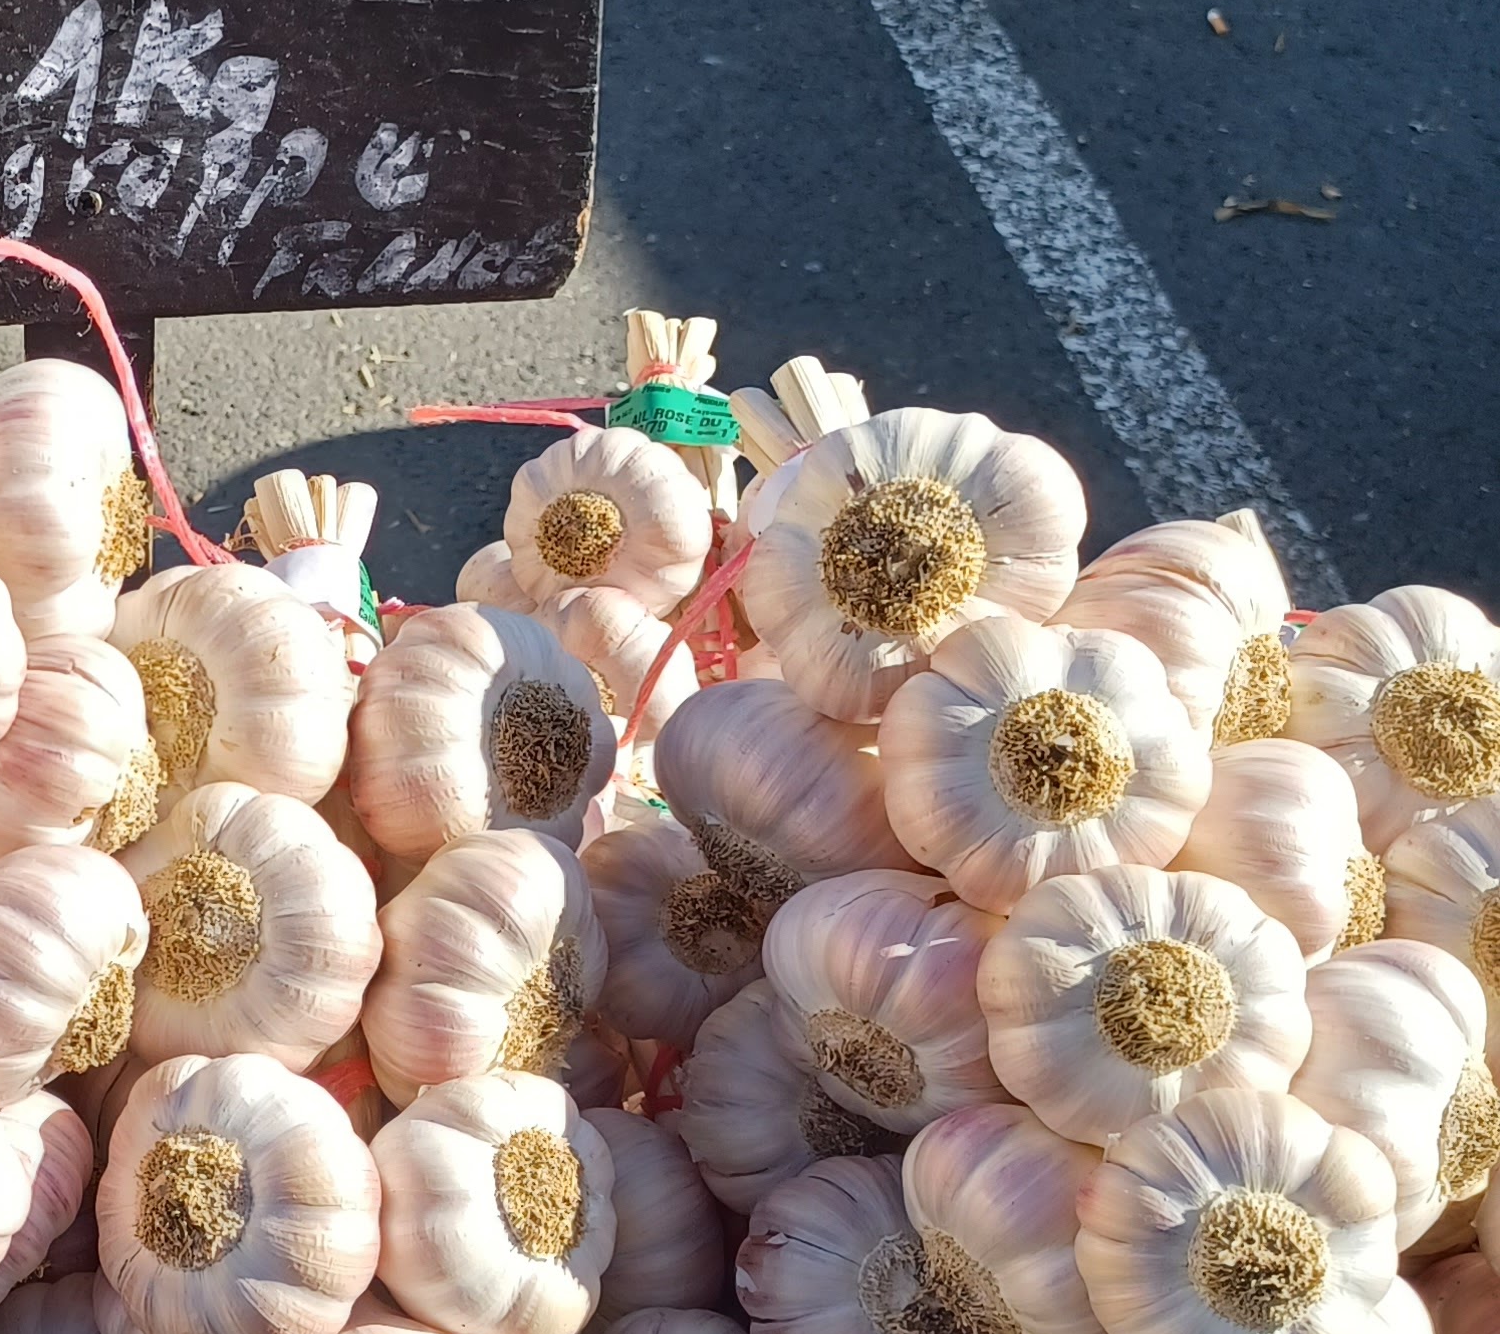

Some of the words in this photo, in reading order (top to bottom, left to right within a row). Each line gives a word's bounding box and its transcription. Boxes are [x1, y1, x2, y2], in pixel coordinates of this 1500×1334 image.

[631, 408, 648, 426] AIL
[653, 407, 694, 426] ROSE
[699, 417, 722, 427] DU
